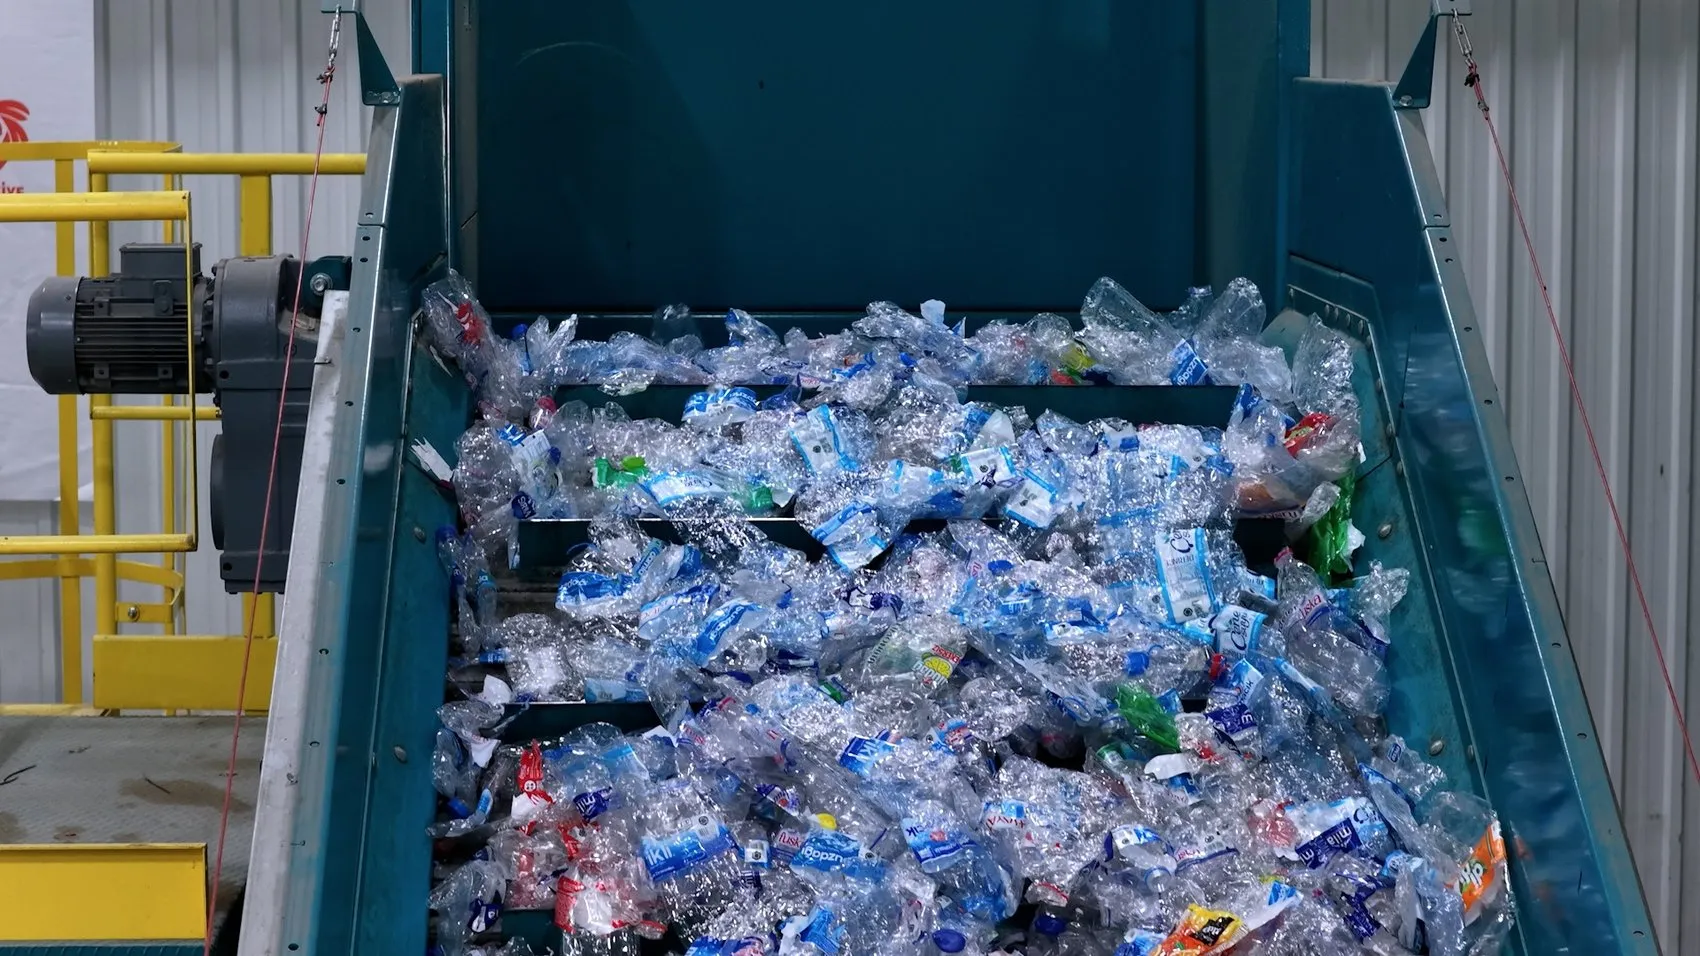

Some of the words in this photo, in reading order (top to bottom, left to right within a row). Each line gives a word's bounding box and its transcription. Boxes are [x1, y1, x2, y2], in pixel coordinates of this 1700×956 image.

[1176, 356, 1200, 386] uzdağı
[1327, 826, 1353, 847] mila
[801, 845, 845, 863] uzdağı
